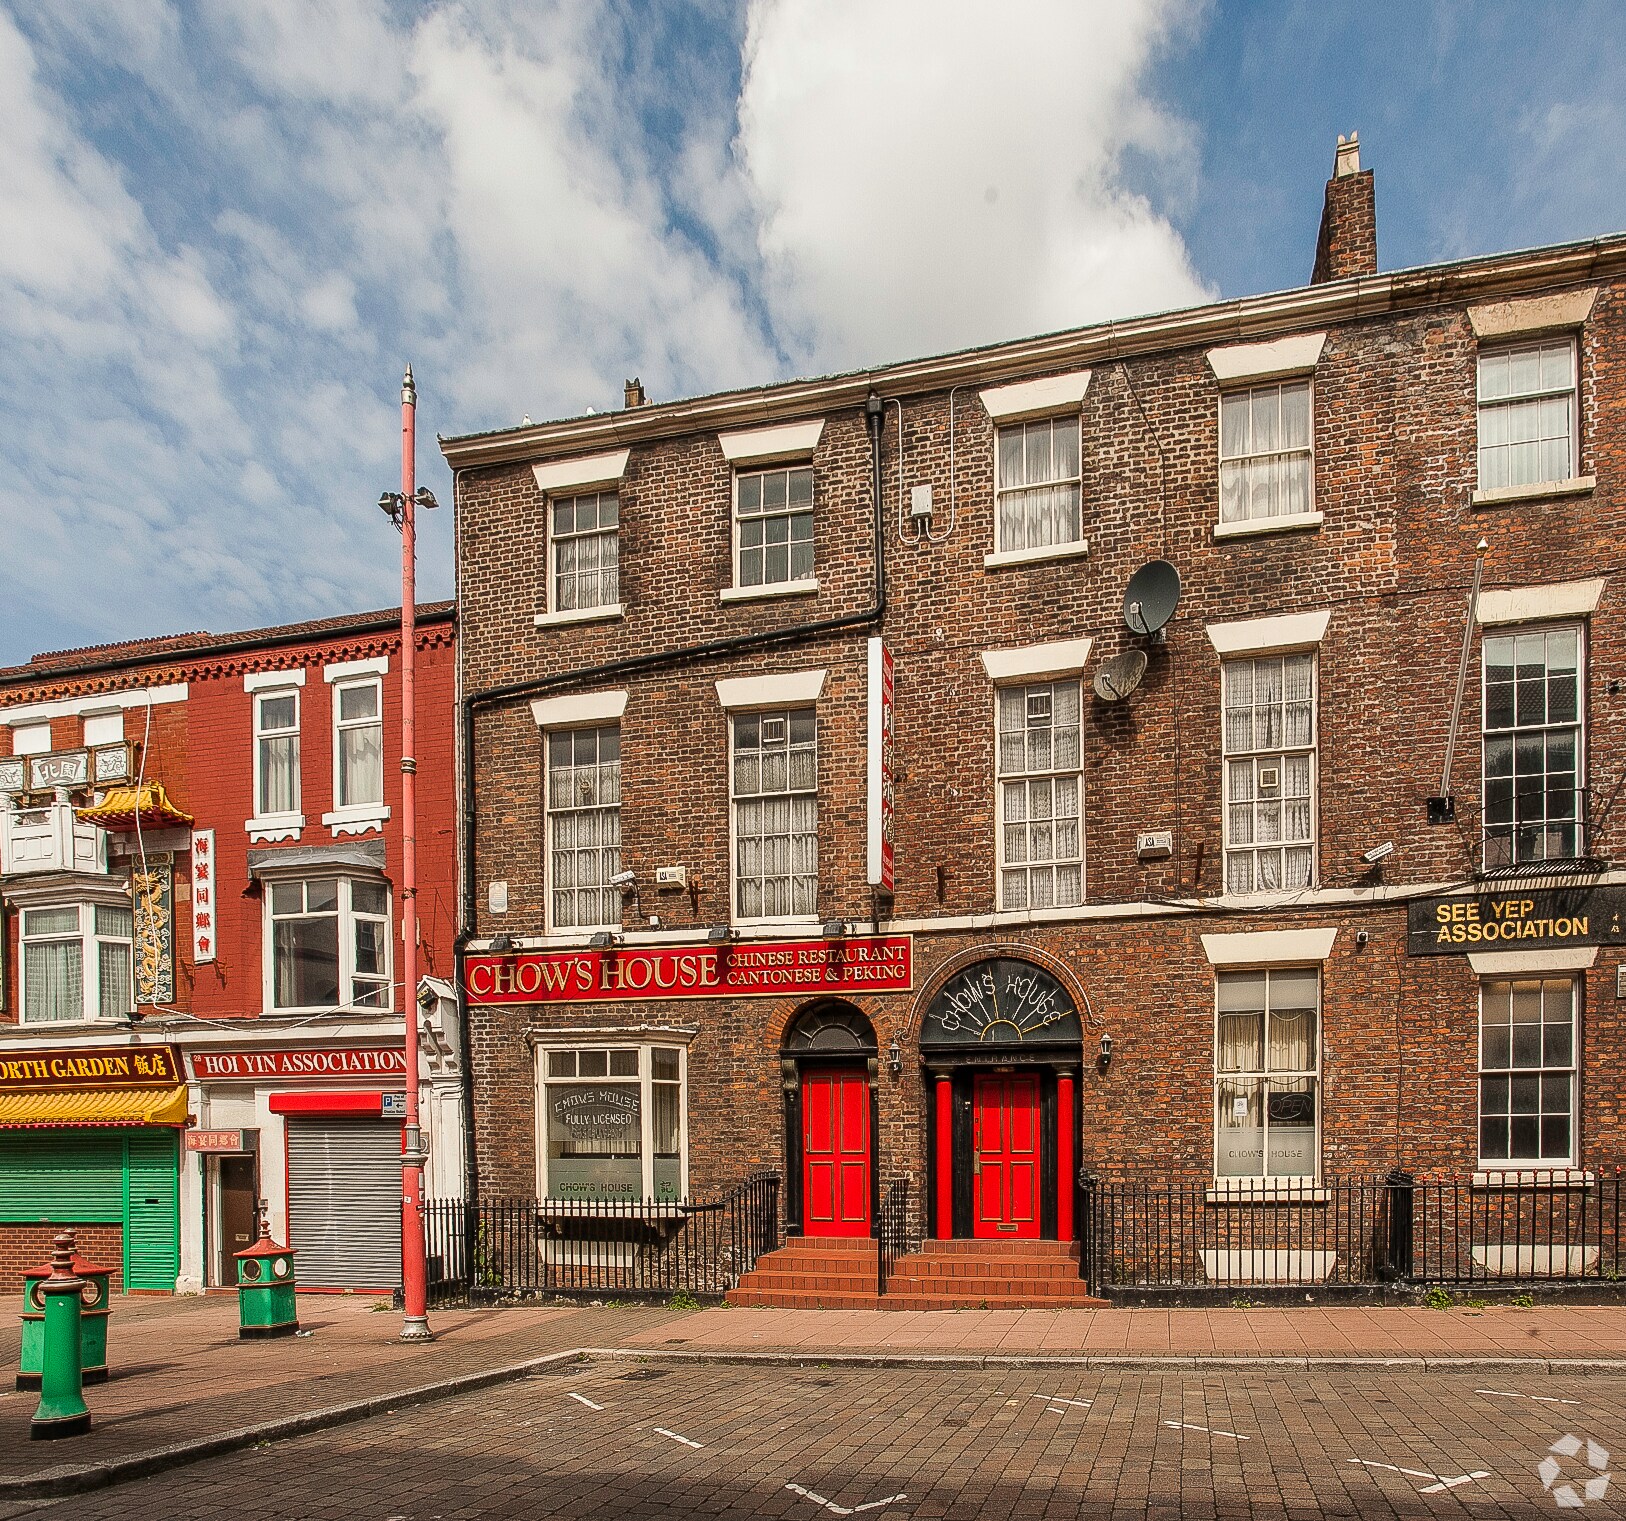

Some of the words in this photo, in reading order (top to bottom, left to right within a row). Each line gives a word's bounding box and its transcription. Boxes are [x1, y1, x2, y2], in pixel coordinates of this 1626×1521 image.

[42, 761, 76, 780] 北園
[1436, 903, 1480, 922] SEE
[1491, 900, 1534, 919] YEP
[1437, 916, 1588, 943] ASSOCIATION
[726, 950, 794, 968] CHINESE
[798, 945, 906, 964] RESTAURANT
[470, 957, 592, 996] CHOW'S
[600, 954, 720, 990] HOUSE
[726, 966, 820, 986] CANTONESE
[825, 966, 839, 982] &
[842, 964, 906, 982] PEKING
[1006, 974, 1060, 1026] HOUSE
[50, 1056, 130, 1078] GARDEN
[134, 1054, 166, 1076] 飯店
[204, 1056, 240, 1074] HOI
[242, 1054, 277, 1072] YIN
[281, 1051, 406, 1072] ASSOCIATION
[600, 1090, 640, 1112] HOUSE
[1270, 1098, 1312, 1113] OPEN
[566, 1114, 590, 1125] FULLY
[592, 1114, 632, 1125] LICENSED
[560, 1182, 596, 1192] CHOW'S
[600, 1183, 634, 1192] HOUSE
